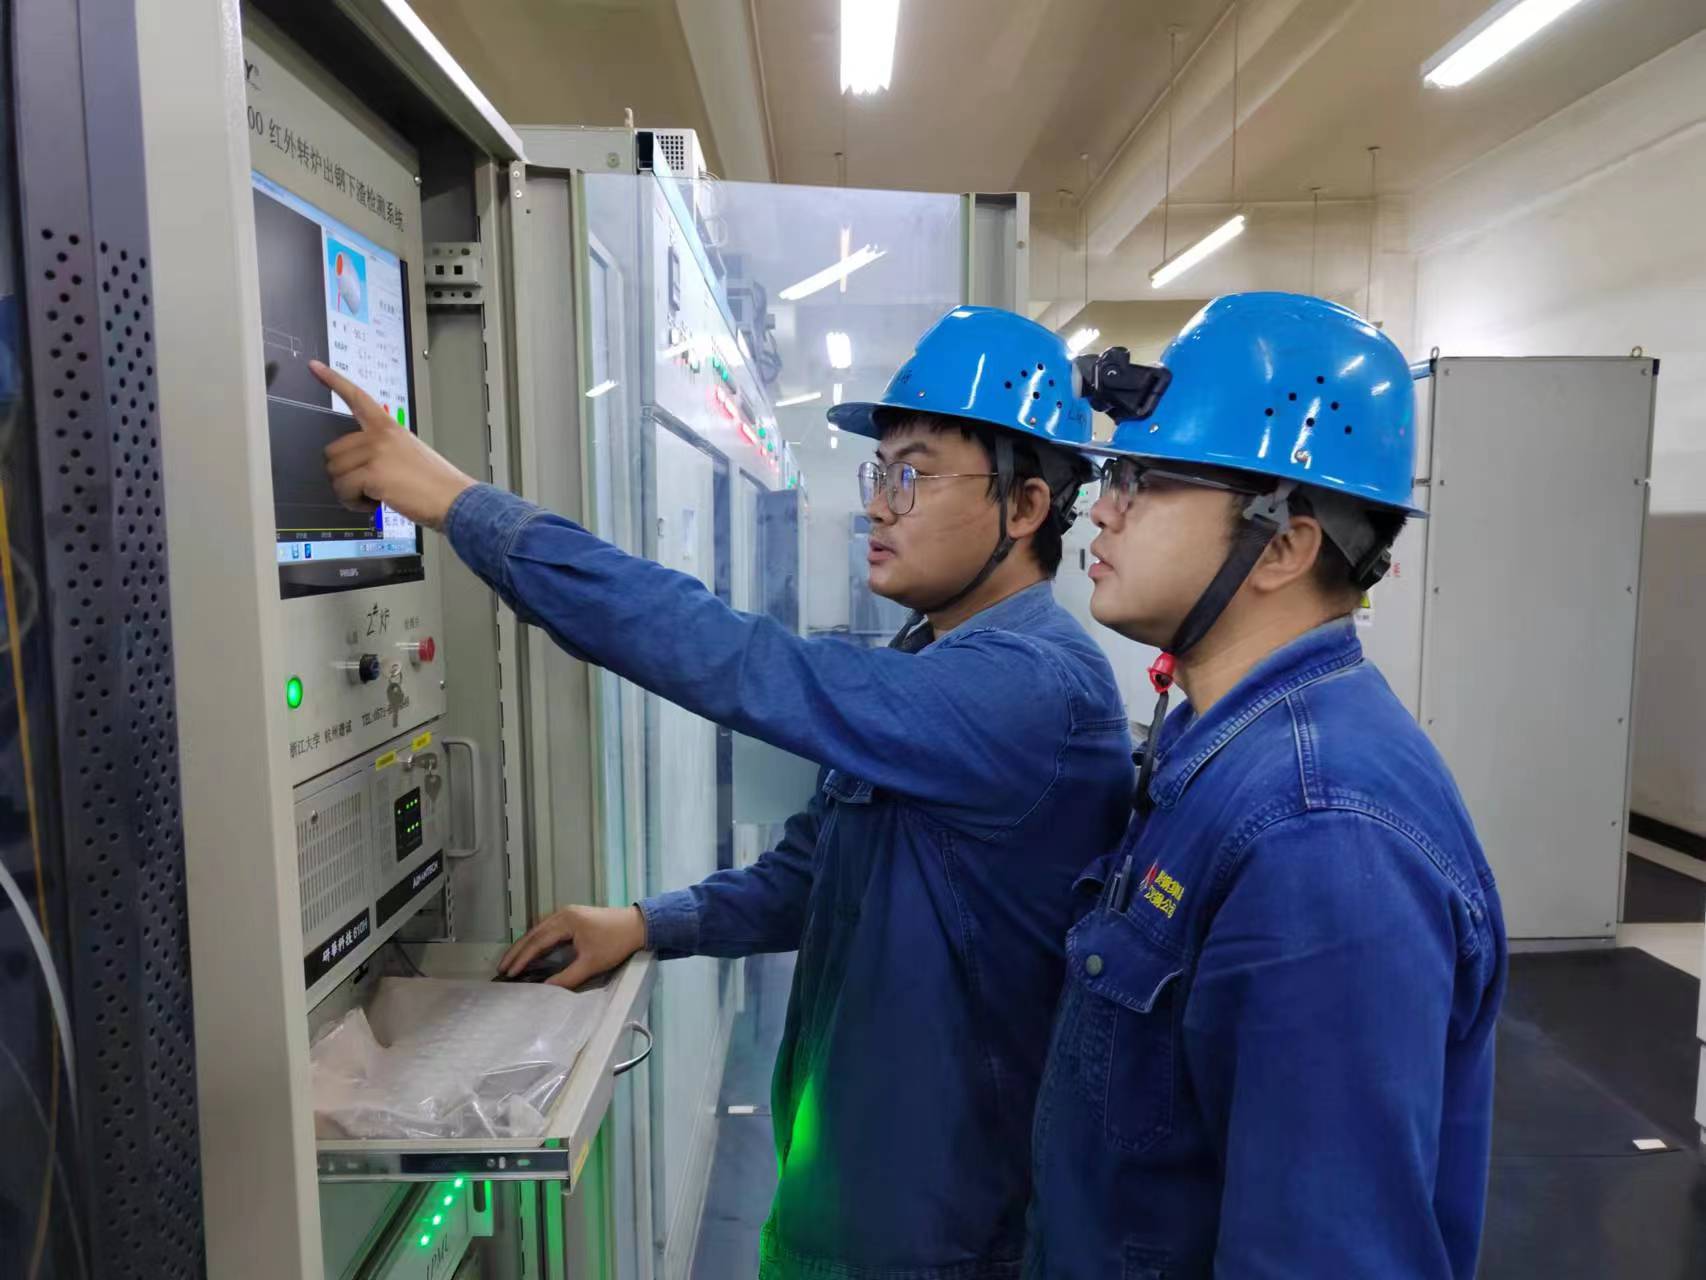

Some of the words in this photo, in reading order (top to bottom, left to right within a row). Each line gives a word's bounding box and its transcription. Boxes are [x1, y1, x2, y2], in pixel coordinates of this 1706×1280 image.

[269, 118, 404, 232] 红外转炉出钢下渣检测系统
[289, 731, 320, 759] 浙江大学
